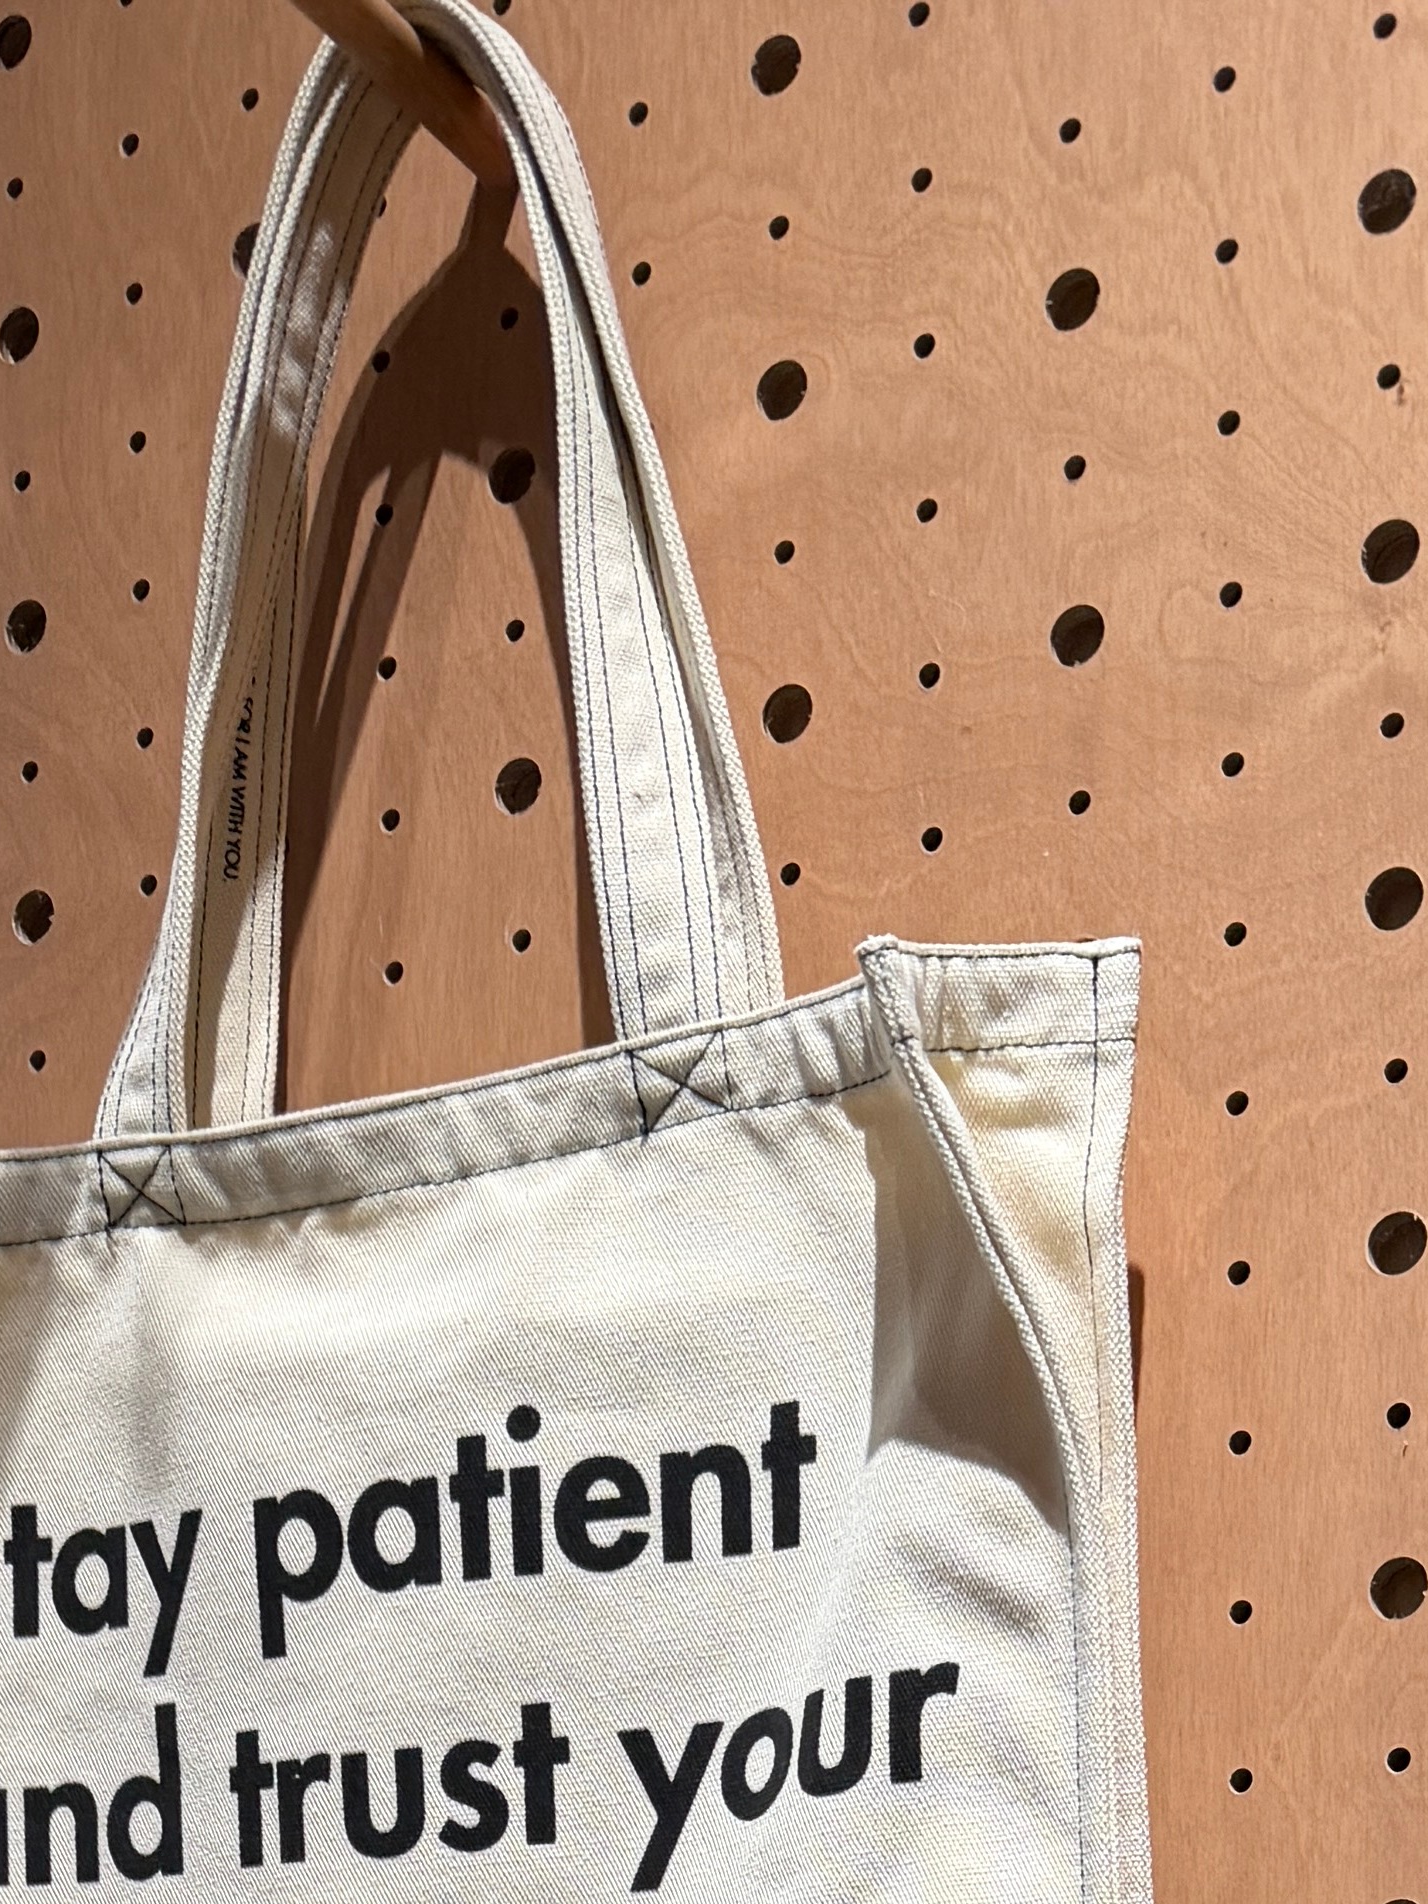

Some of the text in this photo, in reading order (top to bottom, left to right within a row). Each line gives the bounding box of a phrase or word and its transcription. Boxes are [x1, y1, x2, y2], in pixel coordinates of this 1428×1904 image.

[228, 785, 247, 835] WITH
[232, 748, 249, 781] AM
[253, 1402, 817, 1659] patient
[230, 1702, 570, 1868] trust
[618, 1662, 959, 1892] your
